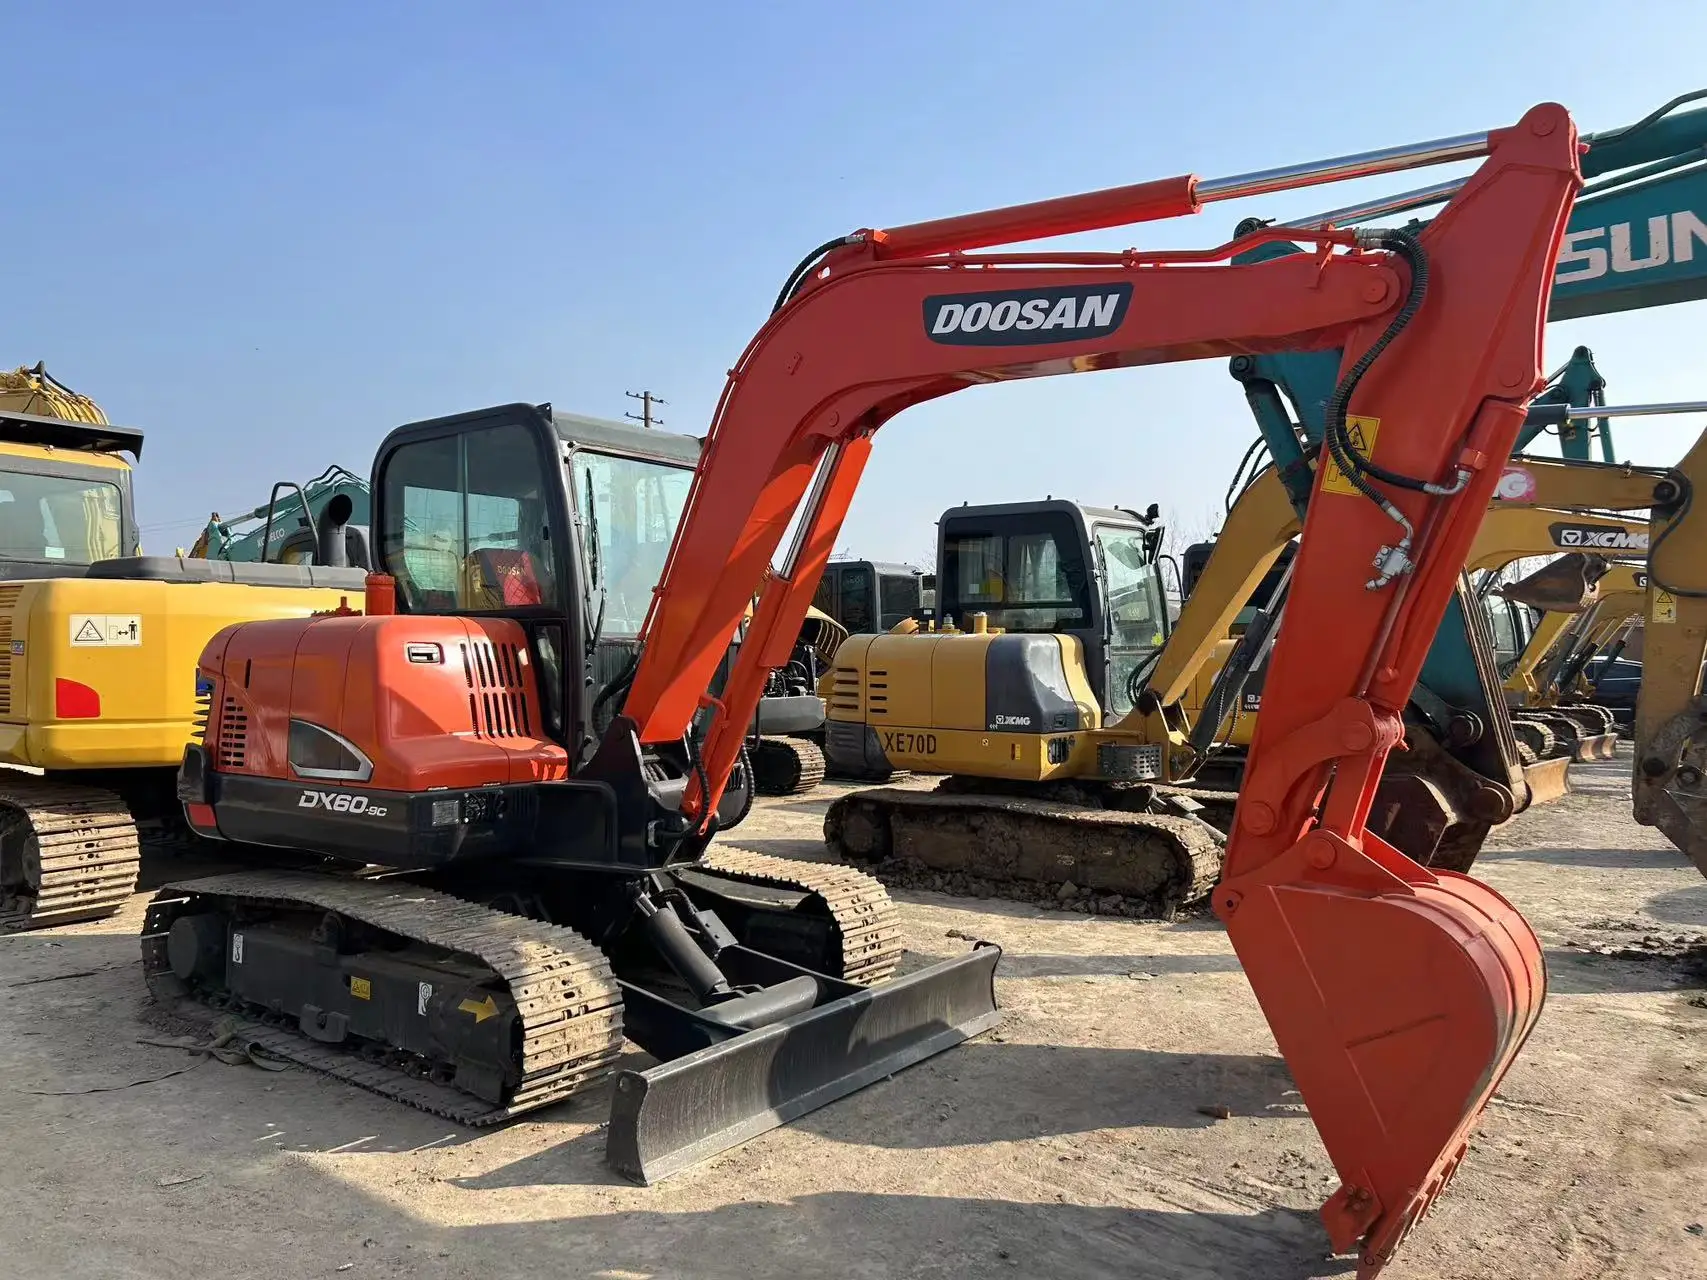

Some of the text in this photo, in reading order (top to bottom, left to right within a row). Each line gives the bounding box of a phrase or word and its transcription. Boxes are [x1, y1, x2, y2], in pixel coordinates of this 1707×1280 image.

[932, 293, 1120, 334] DOOSAN
[1004, 715, 1031, 726] XCMG
[884, 732, 937, 755] XE70D
